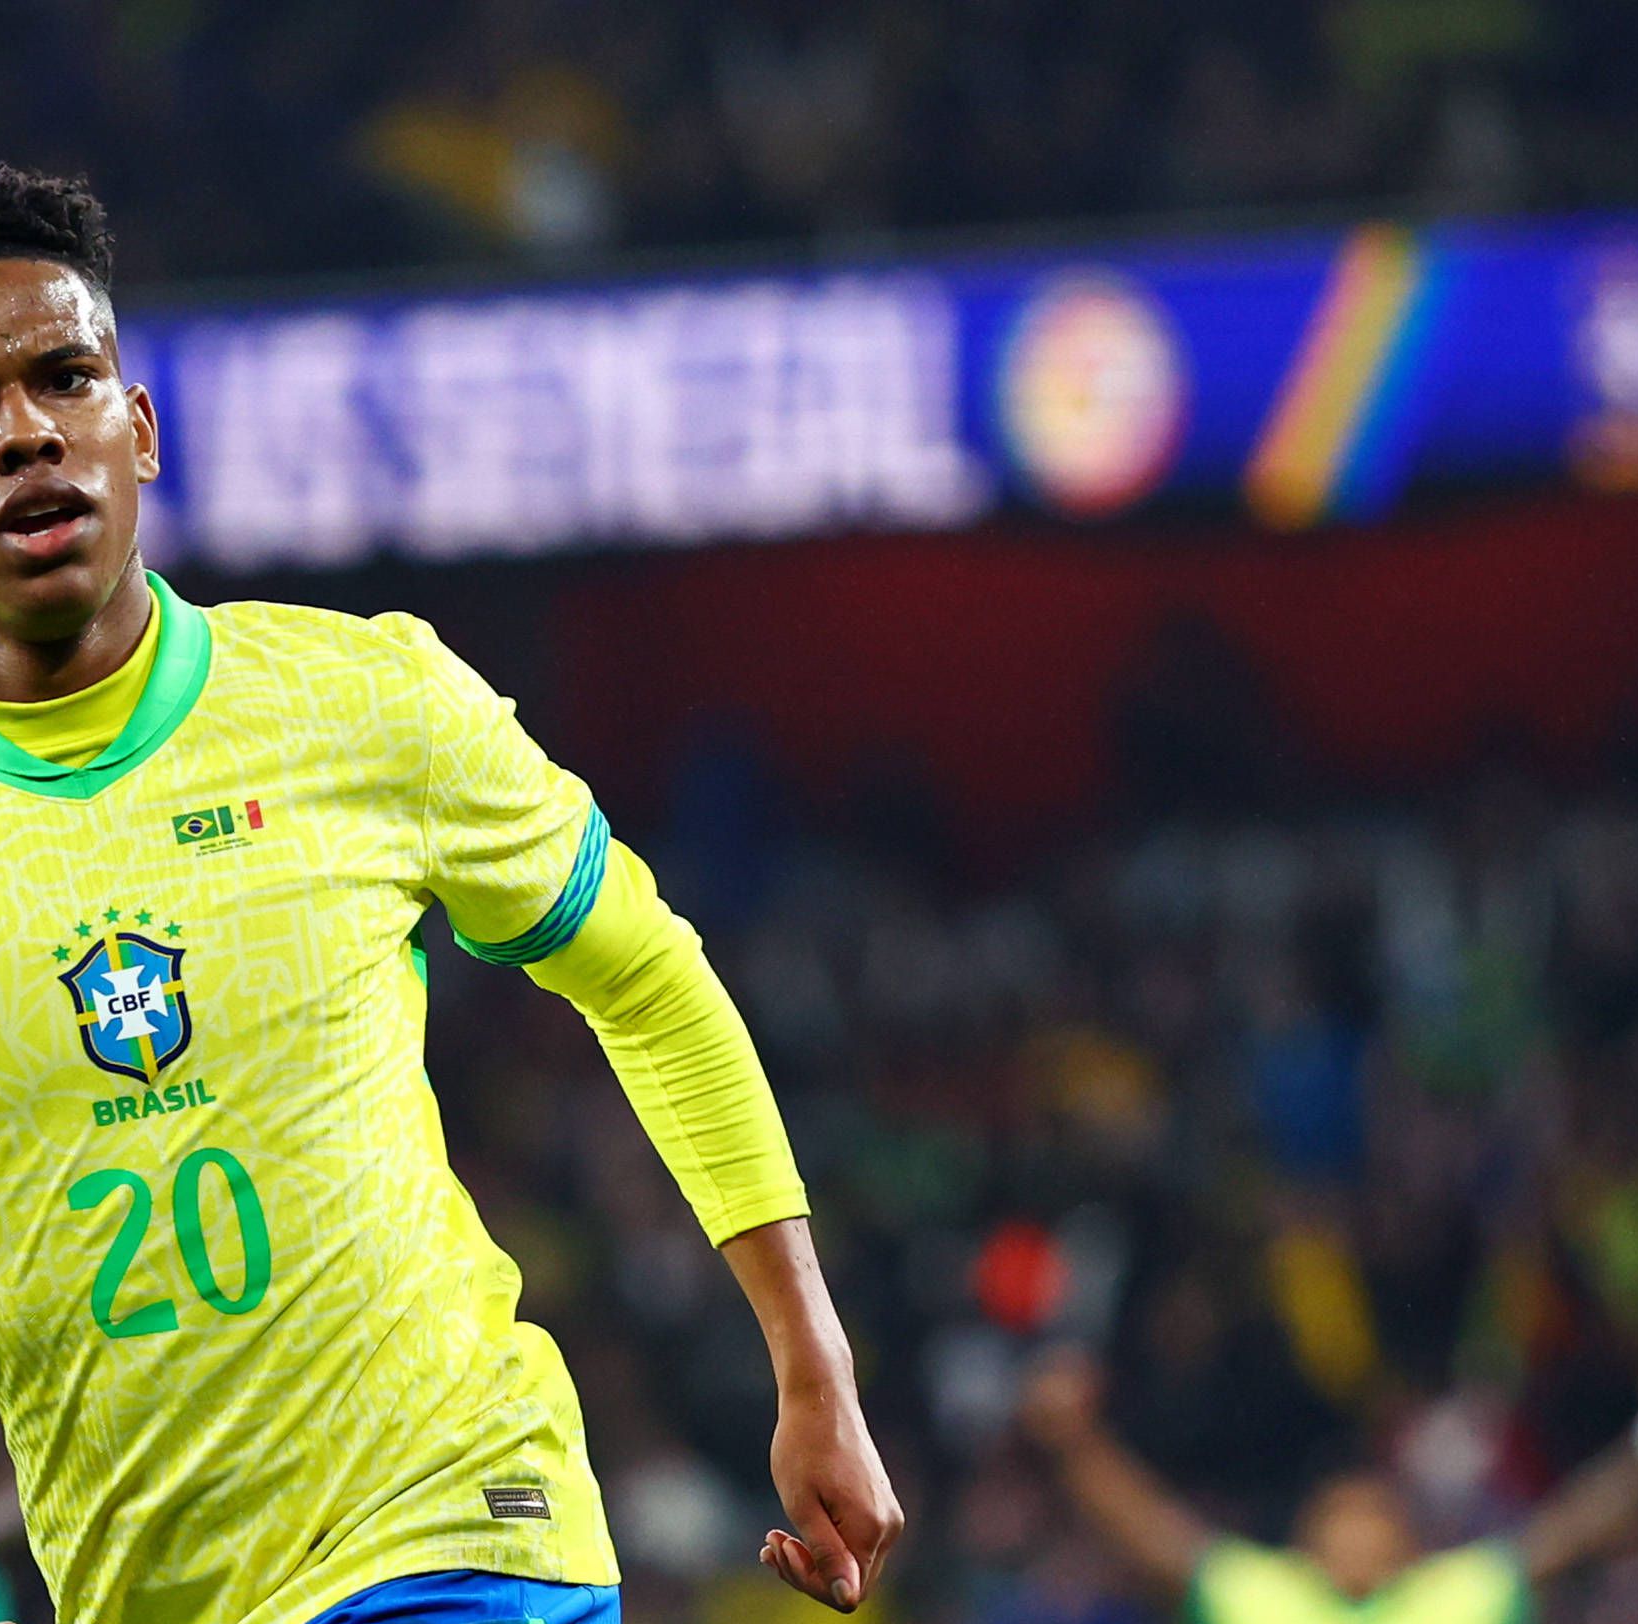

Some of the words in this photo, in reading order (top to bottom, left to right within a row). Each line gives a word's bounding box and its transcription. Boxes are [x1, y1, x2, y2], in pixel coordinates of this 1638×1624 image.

[108, 990, 151, 1015] CBF
[93, 1078, 217, 1127] BRASIL
[67, 1147, 271, 1338] 20
